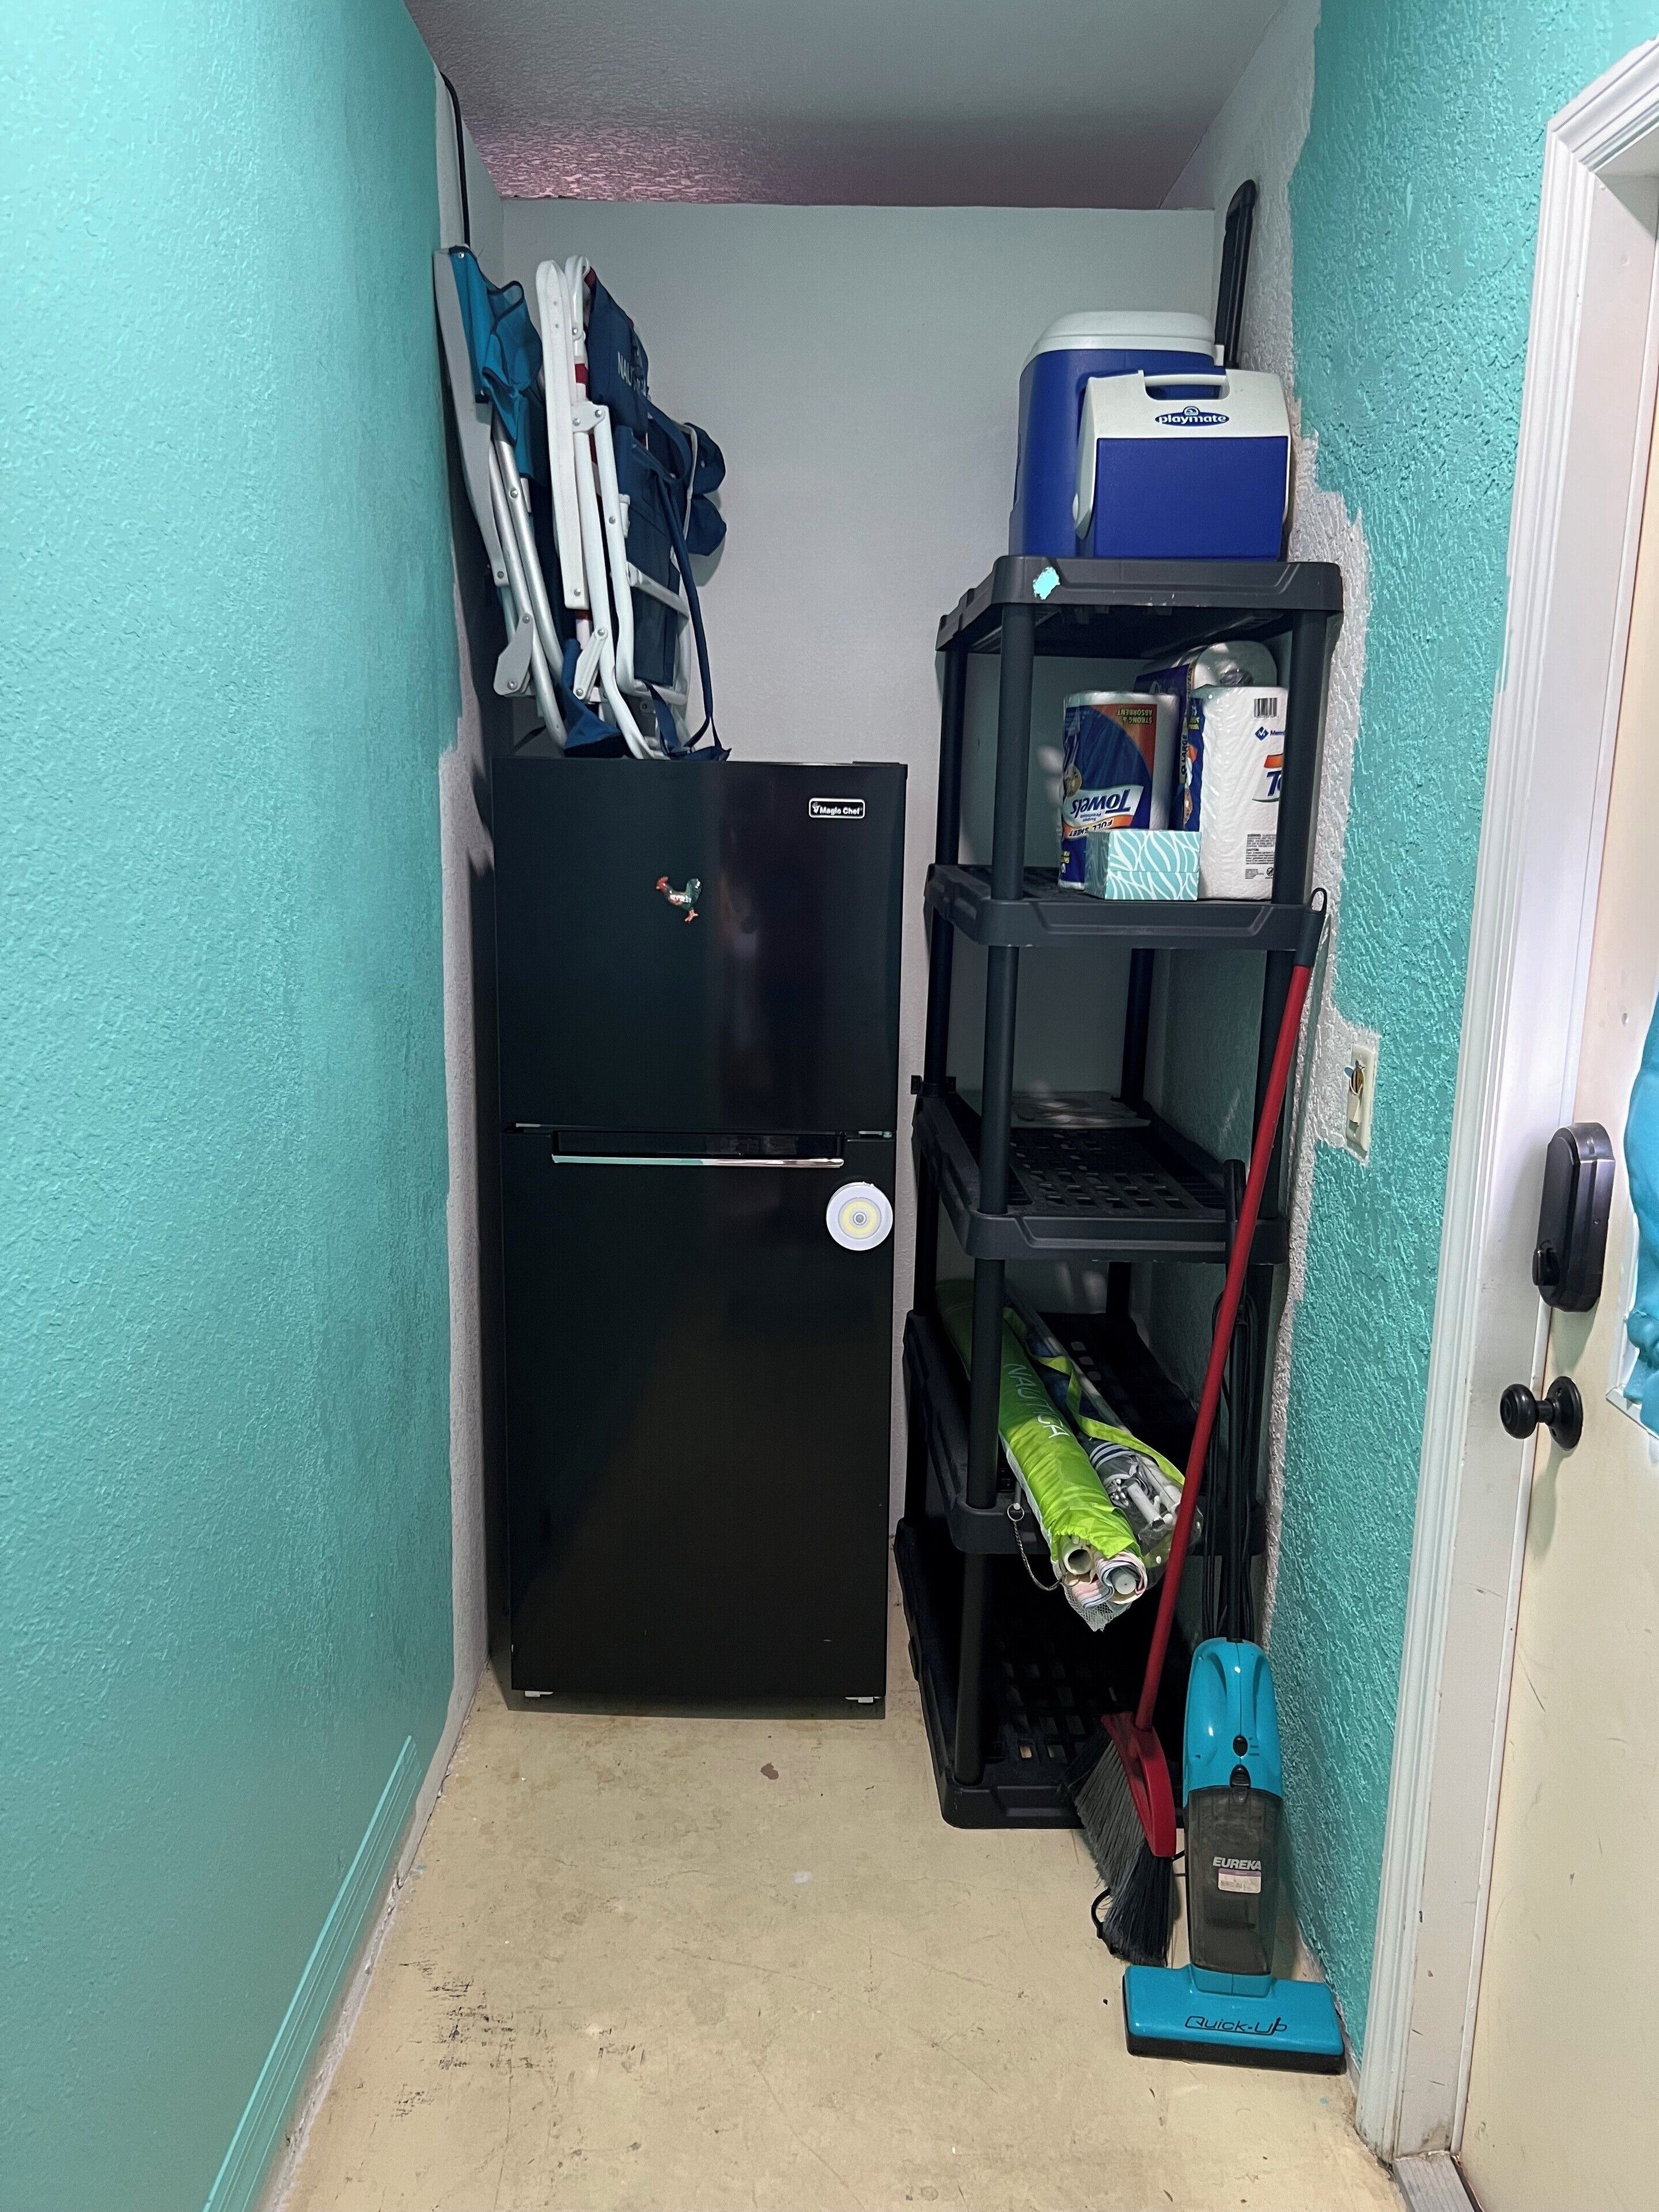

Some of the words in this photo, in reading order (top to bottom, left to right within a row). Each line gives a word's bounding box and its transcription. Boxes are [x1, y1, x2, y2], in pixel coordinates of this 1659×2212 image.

[1158, 415, 1226, 425] playmate
[1070, 789, 1131, 819] Towels
[820, 806, 841, 816] Magic
[1093, 819, 1113, 831] FULL
[1003, 1363, 1070, 1439] NAUTICA
[1213, 1856, 1262, 1870] EUREKA
